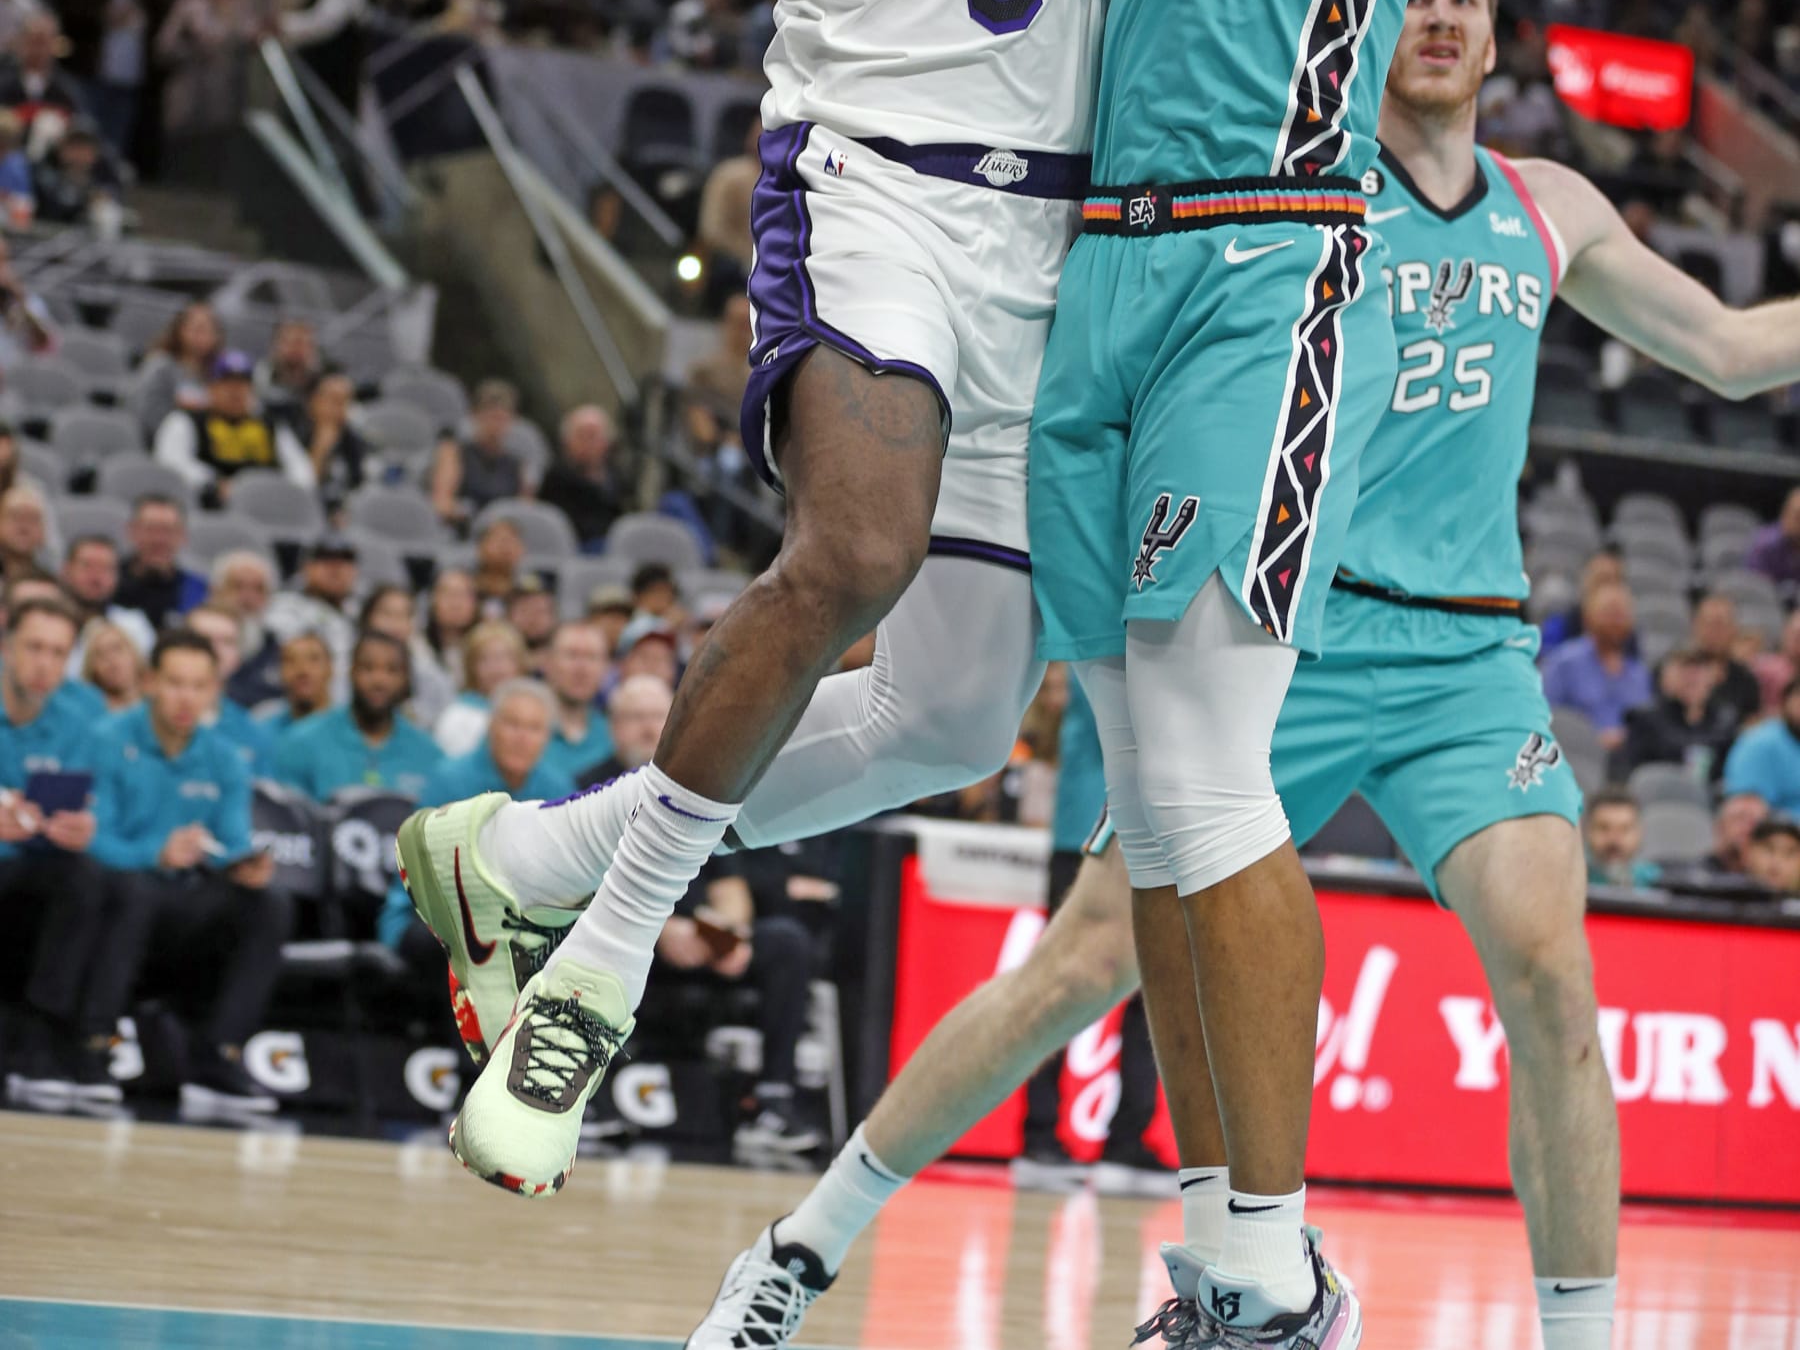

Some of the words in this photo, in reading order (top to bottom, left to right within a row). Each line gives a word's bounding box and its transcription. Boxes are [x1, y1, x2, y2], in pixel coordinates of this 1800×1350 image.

[1360, 169, 1378, 195] 6
[1391, 338, 1496, 414] 25
[243, 1030, 311, 1094] G
[404, 1047, 462, 1112] G
[1438, 994, 1730, 1107] YUR
[612, 1063, 678, 1128] G
